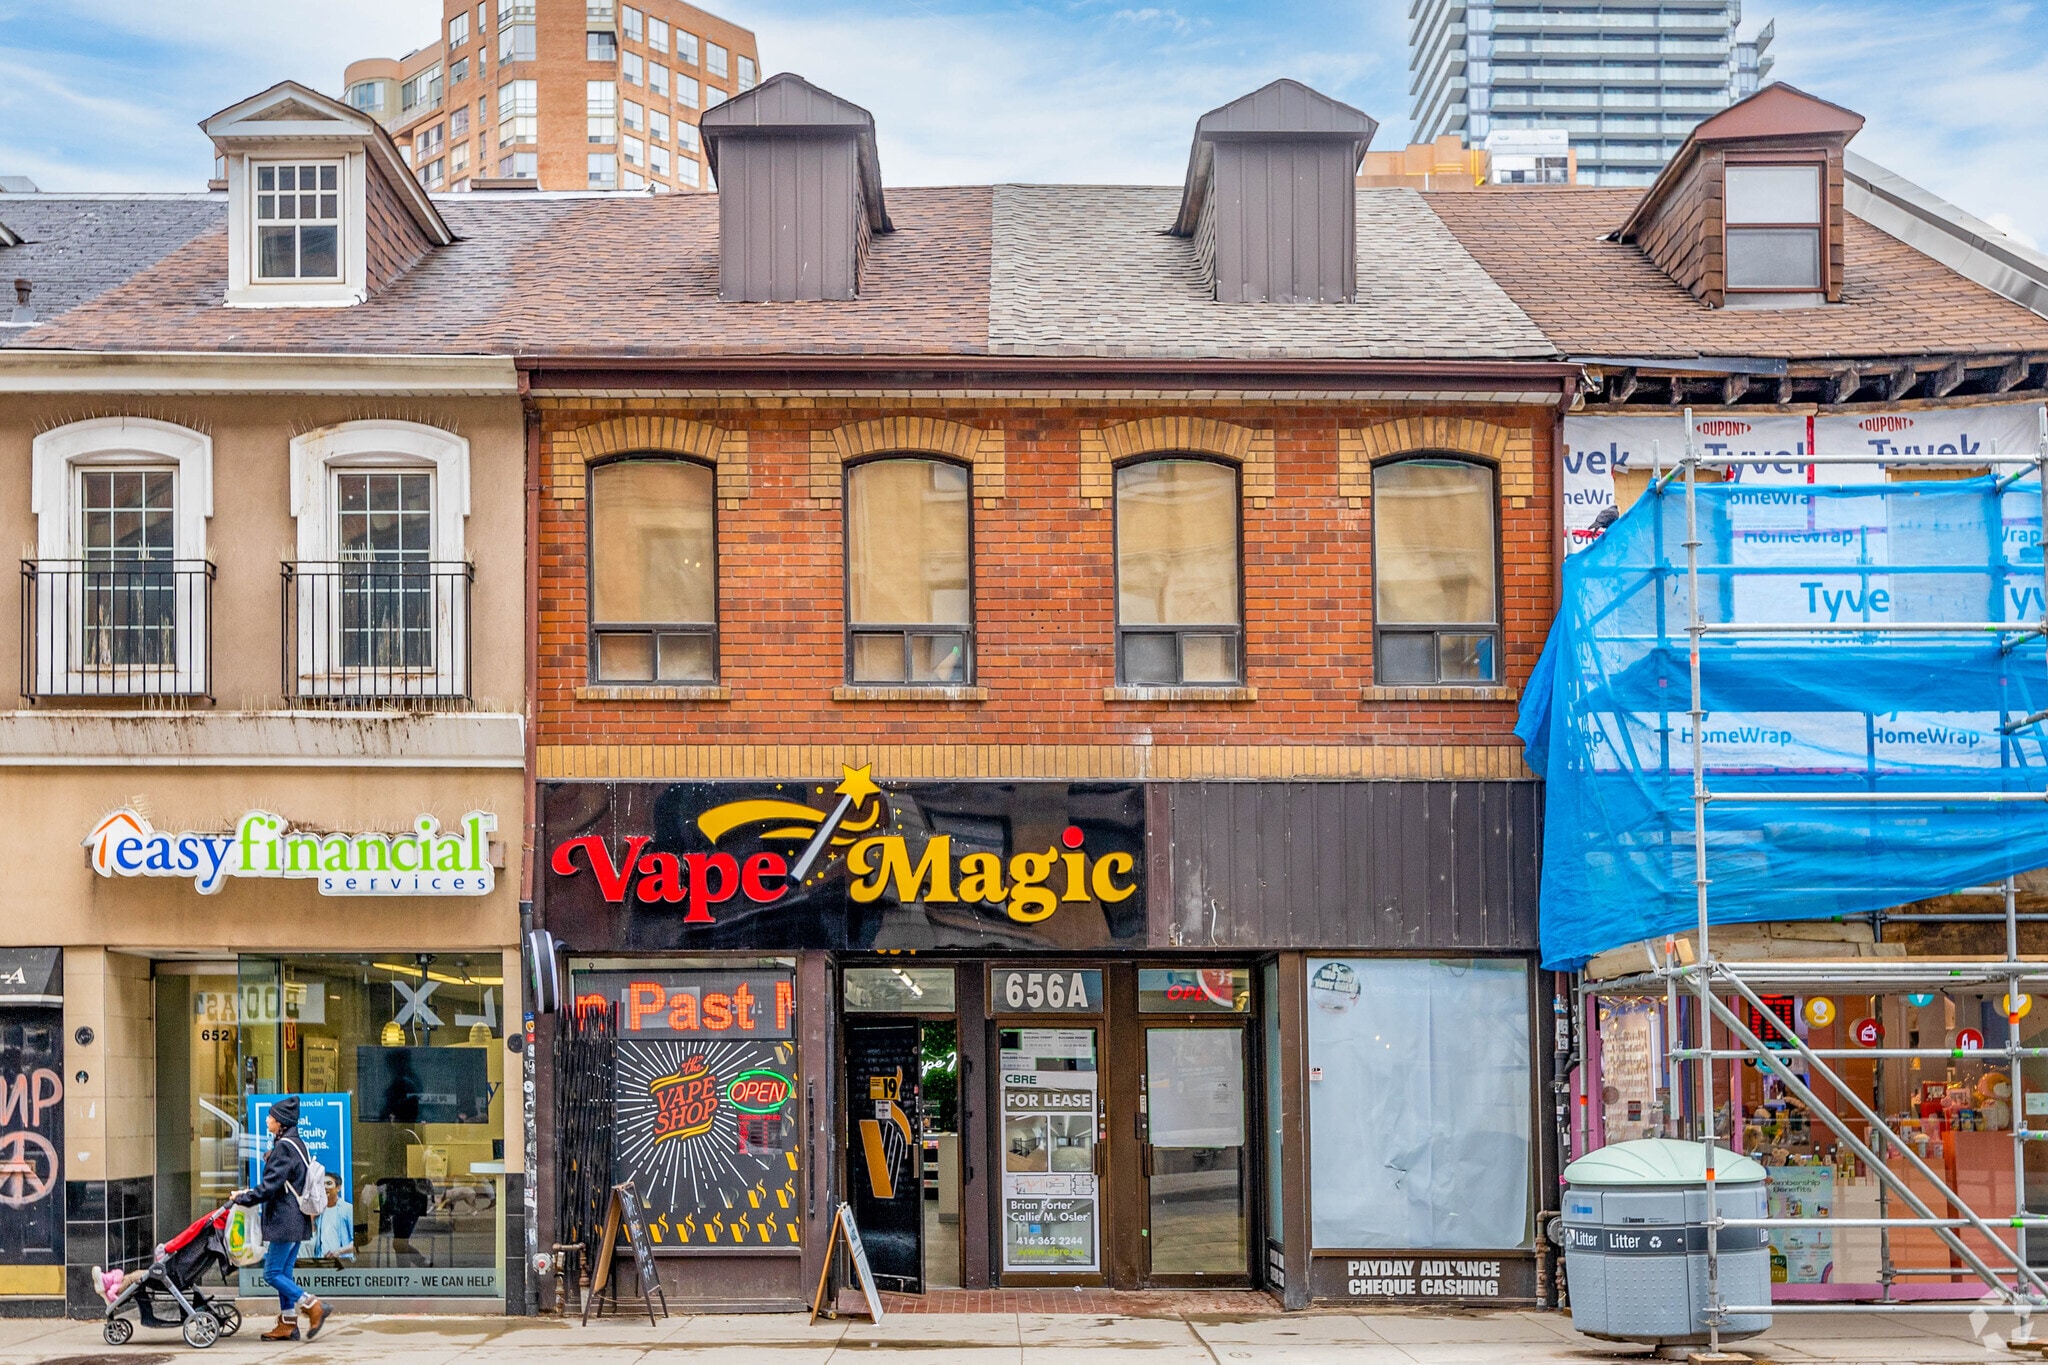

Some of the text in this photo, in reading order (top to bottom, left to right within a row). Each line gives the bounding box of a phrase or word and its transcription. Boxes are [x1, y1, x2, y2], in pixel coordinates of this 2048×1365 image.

[1703, 420, 1746, 436] DUPONT
[1865, 416, 1908, 432] DUPONT
[1681, 727, 1792, 747] HomeWrap
[1873, 728, 1980, 748] HomeWrap
[324, 874, 486, 890] services
[551, 825, 1137, 923] Vape Magic
[1005, 972, 1089, 1008] 656A
[629, 981, 755, 1031] Past
[201, 1029, 230, 1041] 652
[882, 1077, 898, 1099] 19
[1005, 1074, 1037, 1085] CBRE
[656, 1075, 717, 1111] VAPE
[729, 1081, 787, 1103] OPEN
[1006, 1093, 1091, 1107] FOR LEASE
[654, 1098, 718, 1135] SHOP
[1011, 1200, 1038, 1210] Brian
[1011, 1212, 1040, 1222] Callie
[1043, 1213, 1056, 1221] M.
[1016, 1237, 1083, 1245] 416 362 2244
[1575, 1230, 1598, 1247] Litter
[1609, 1232, 1641, 1249] Litter
[1347, 1260, 1414, 1277] PAYDAY
[314, 1276, 361, 1288] PERFECT
[364, 1276, 410, 1288] CREDIT?
[421, 1276, 439, 1287] WE
[441, 1276, 464, 1287] CAN
[1348, 1278, 1499, 1297] CHEQUE CASHING
